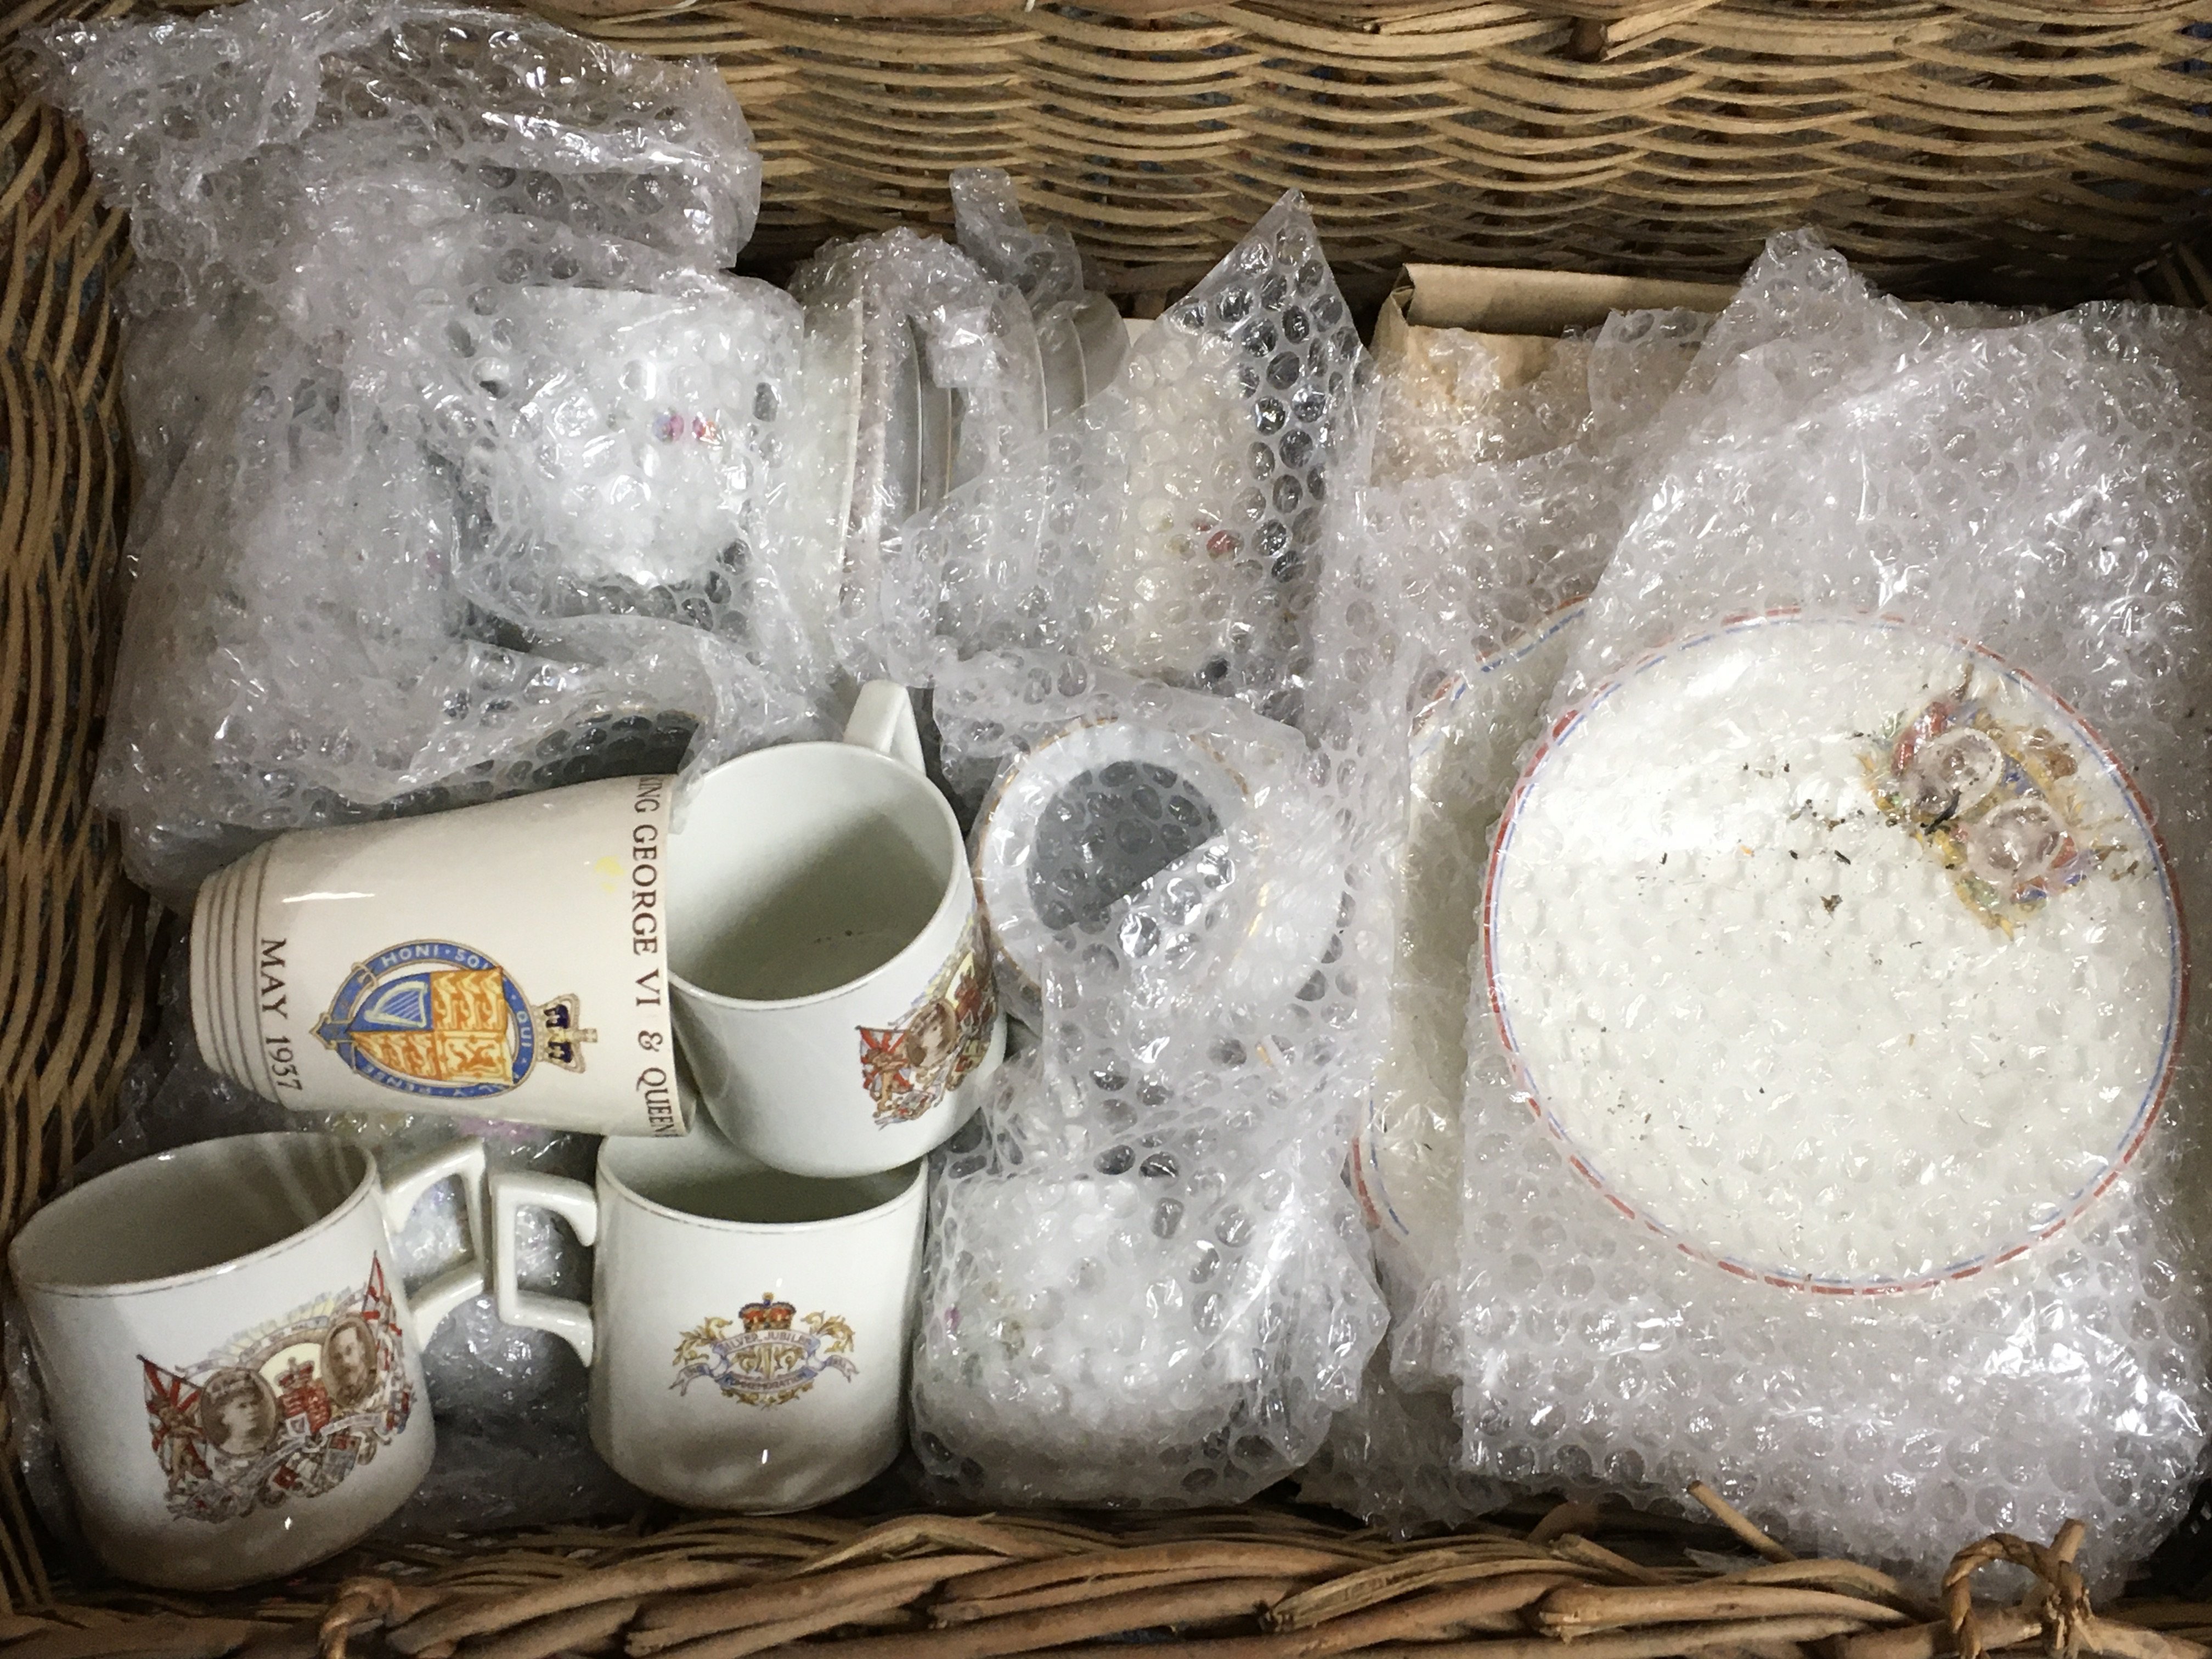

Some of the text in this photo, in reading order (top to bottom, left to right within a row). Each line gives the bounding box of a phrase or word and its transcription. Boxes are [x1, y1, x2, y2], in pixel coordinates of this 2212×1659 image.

[632, 824, 658, 956] GEORGE
[261, 938, 303, 1091] MAY 1937
[380, 944, 439, 967] HONI
[516, 1011, 532, 1048] QUI
[635, 968, 661, 1007] VI
[637, 1030, 663, 1052] &
